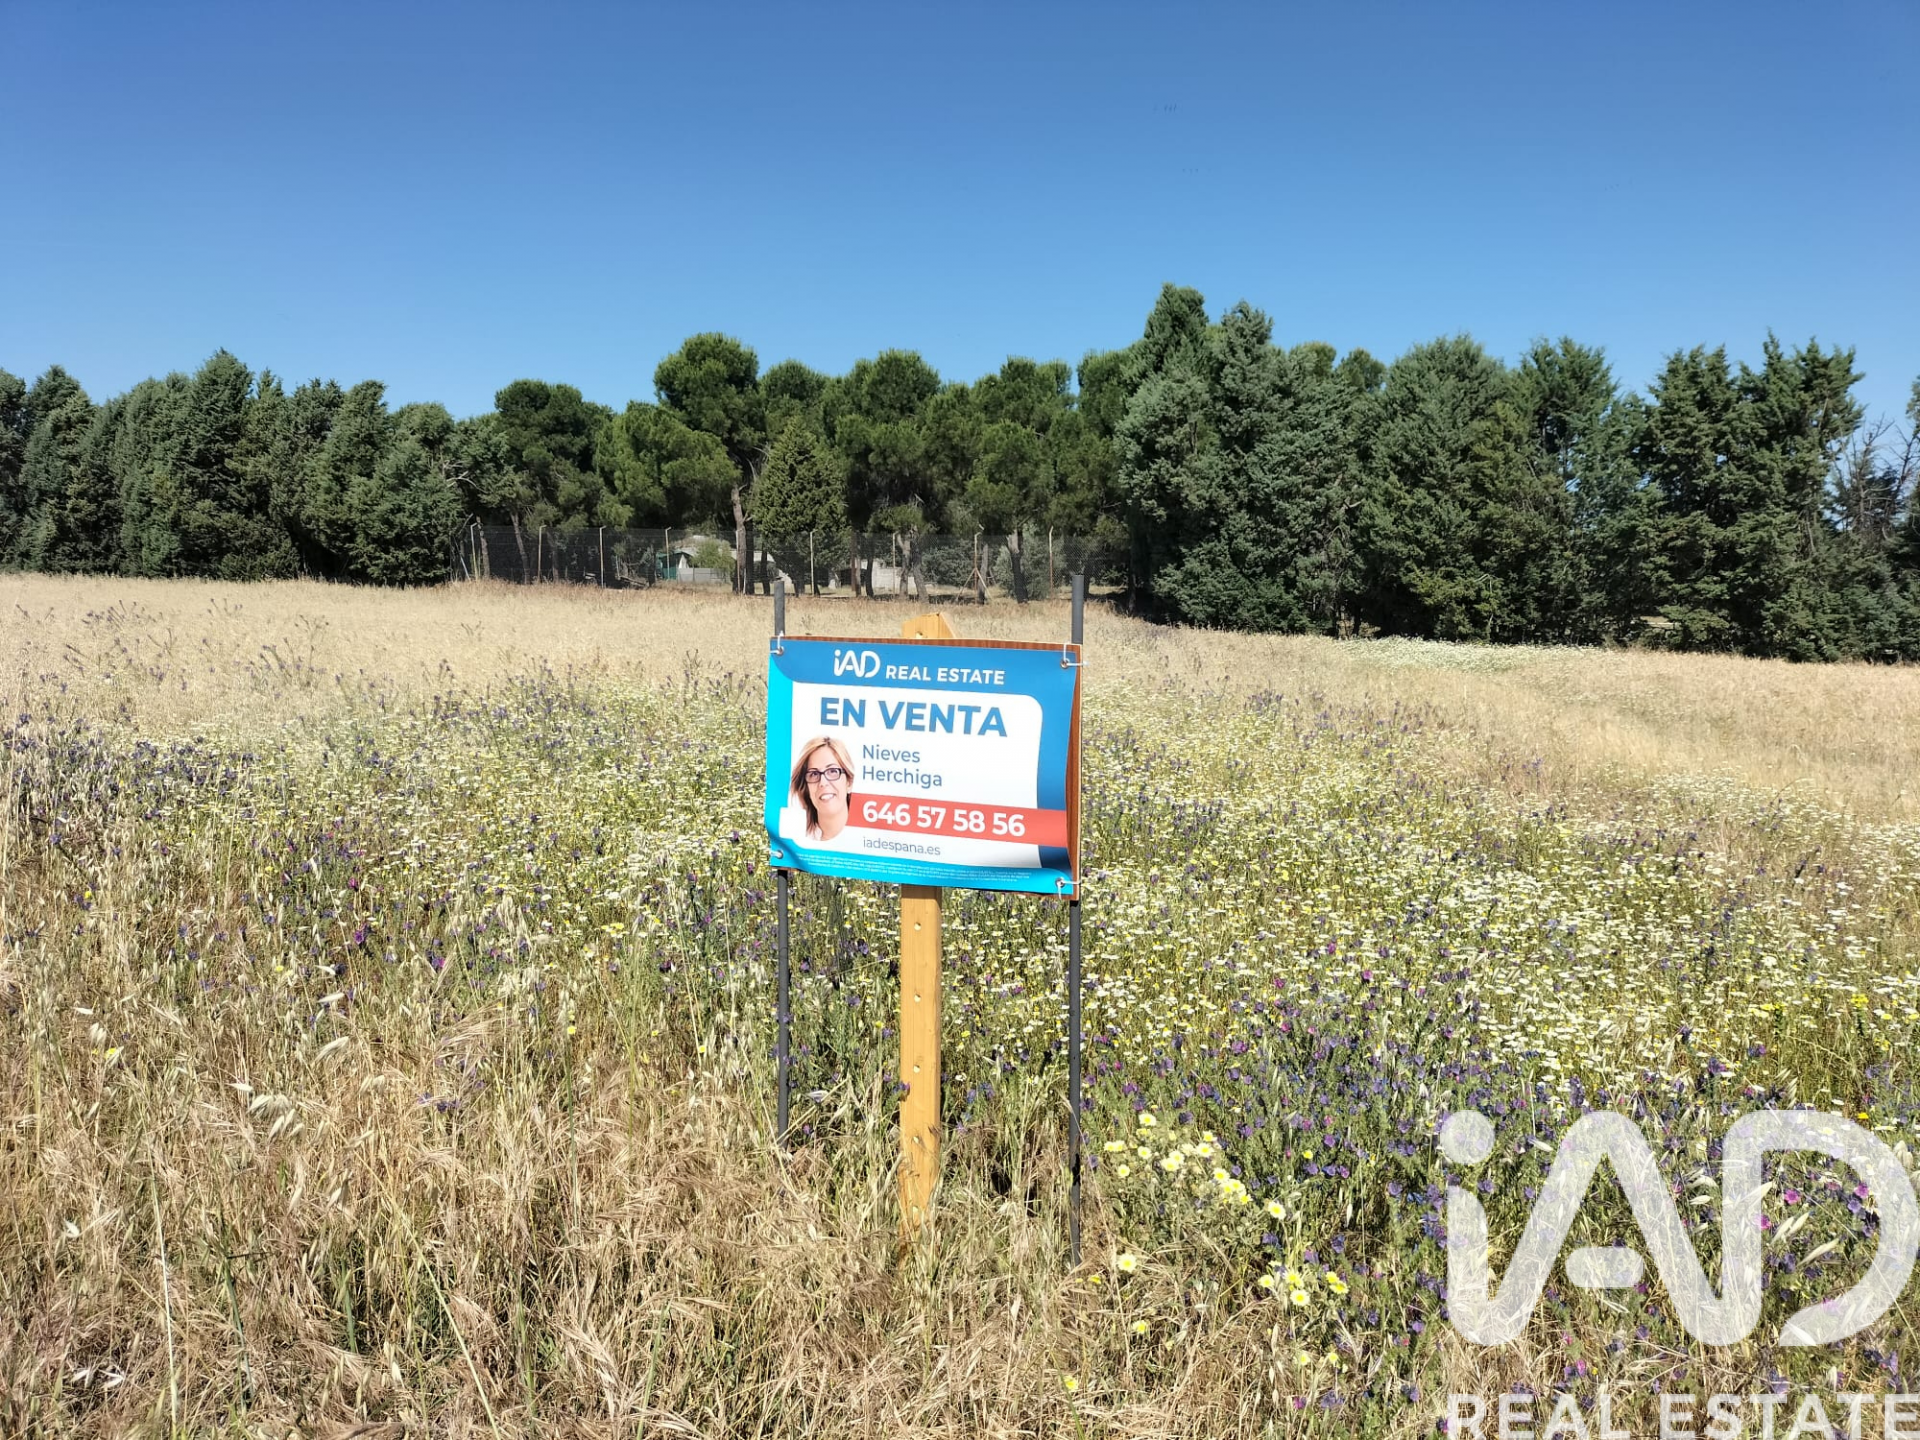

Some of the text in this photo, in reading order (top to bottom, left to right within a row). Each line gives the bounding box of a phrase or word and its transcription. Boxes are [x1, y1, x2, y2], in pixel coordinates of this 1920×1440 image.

[886, 665, 931, 681] REAL
[937, 668, 1005, 685] ESTATE
[820, 697, 1008, 737] EN VENTA
[862, 744, 921, 763] Nieves
[862, 765, 943, 789] Herchiga
[863, 801, 1025, 836] 646 57 58 56
[863, 837, 941, 856] iadespana.es
